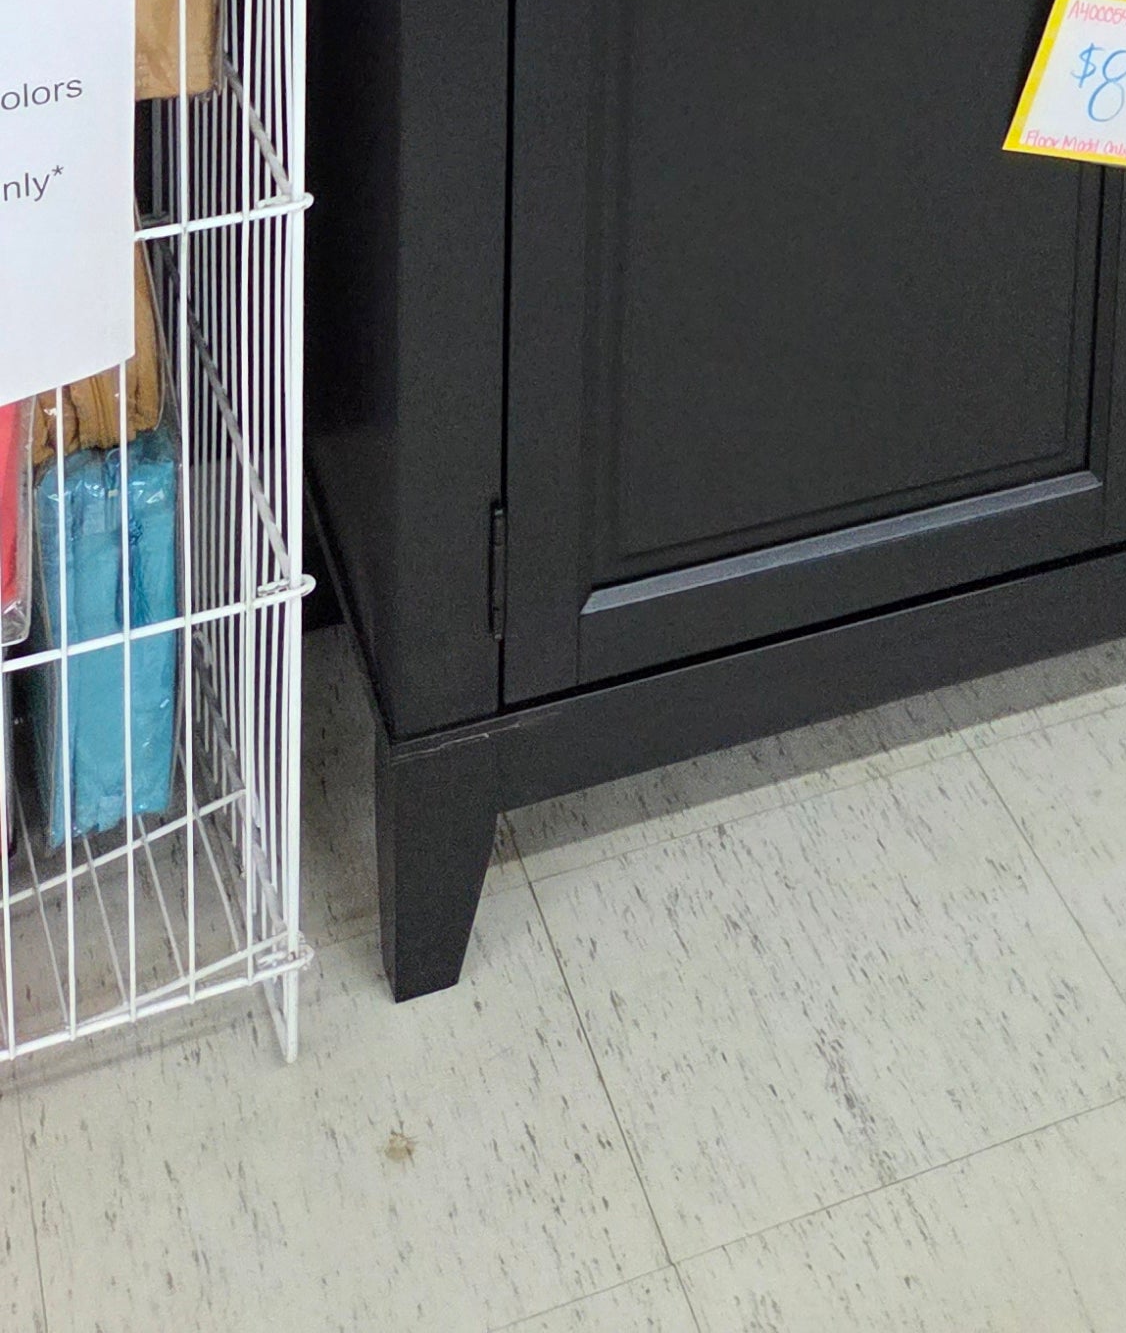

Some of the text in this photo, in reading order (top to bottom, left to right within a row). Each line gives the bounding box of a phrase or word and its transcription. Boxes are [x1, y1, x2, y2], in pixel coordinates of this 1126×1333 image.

[0, 77, 83, 110] olors
[1025, 130, 1059, 148] Floor
[3, 165, 64, 202] nly
